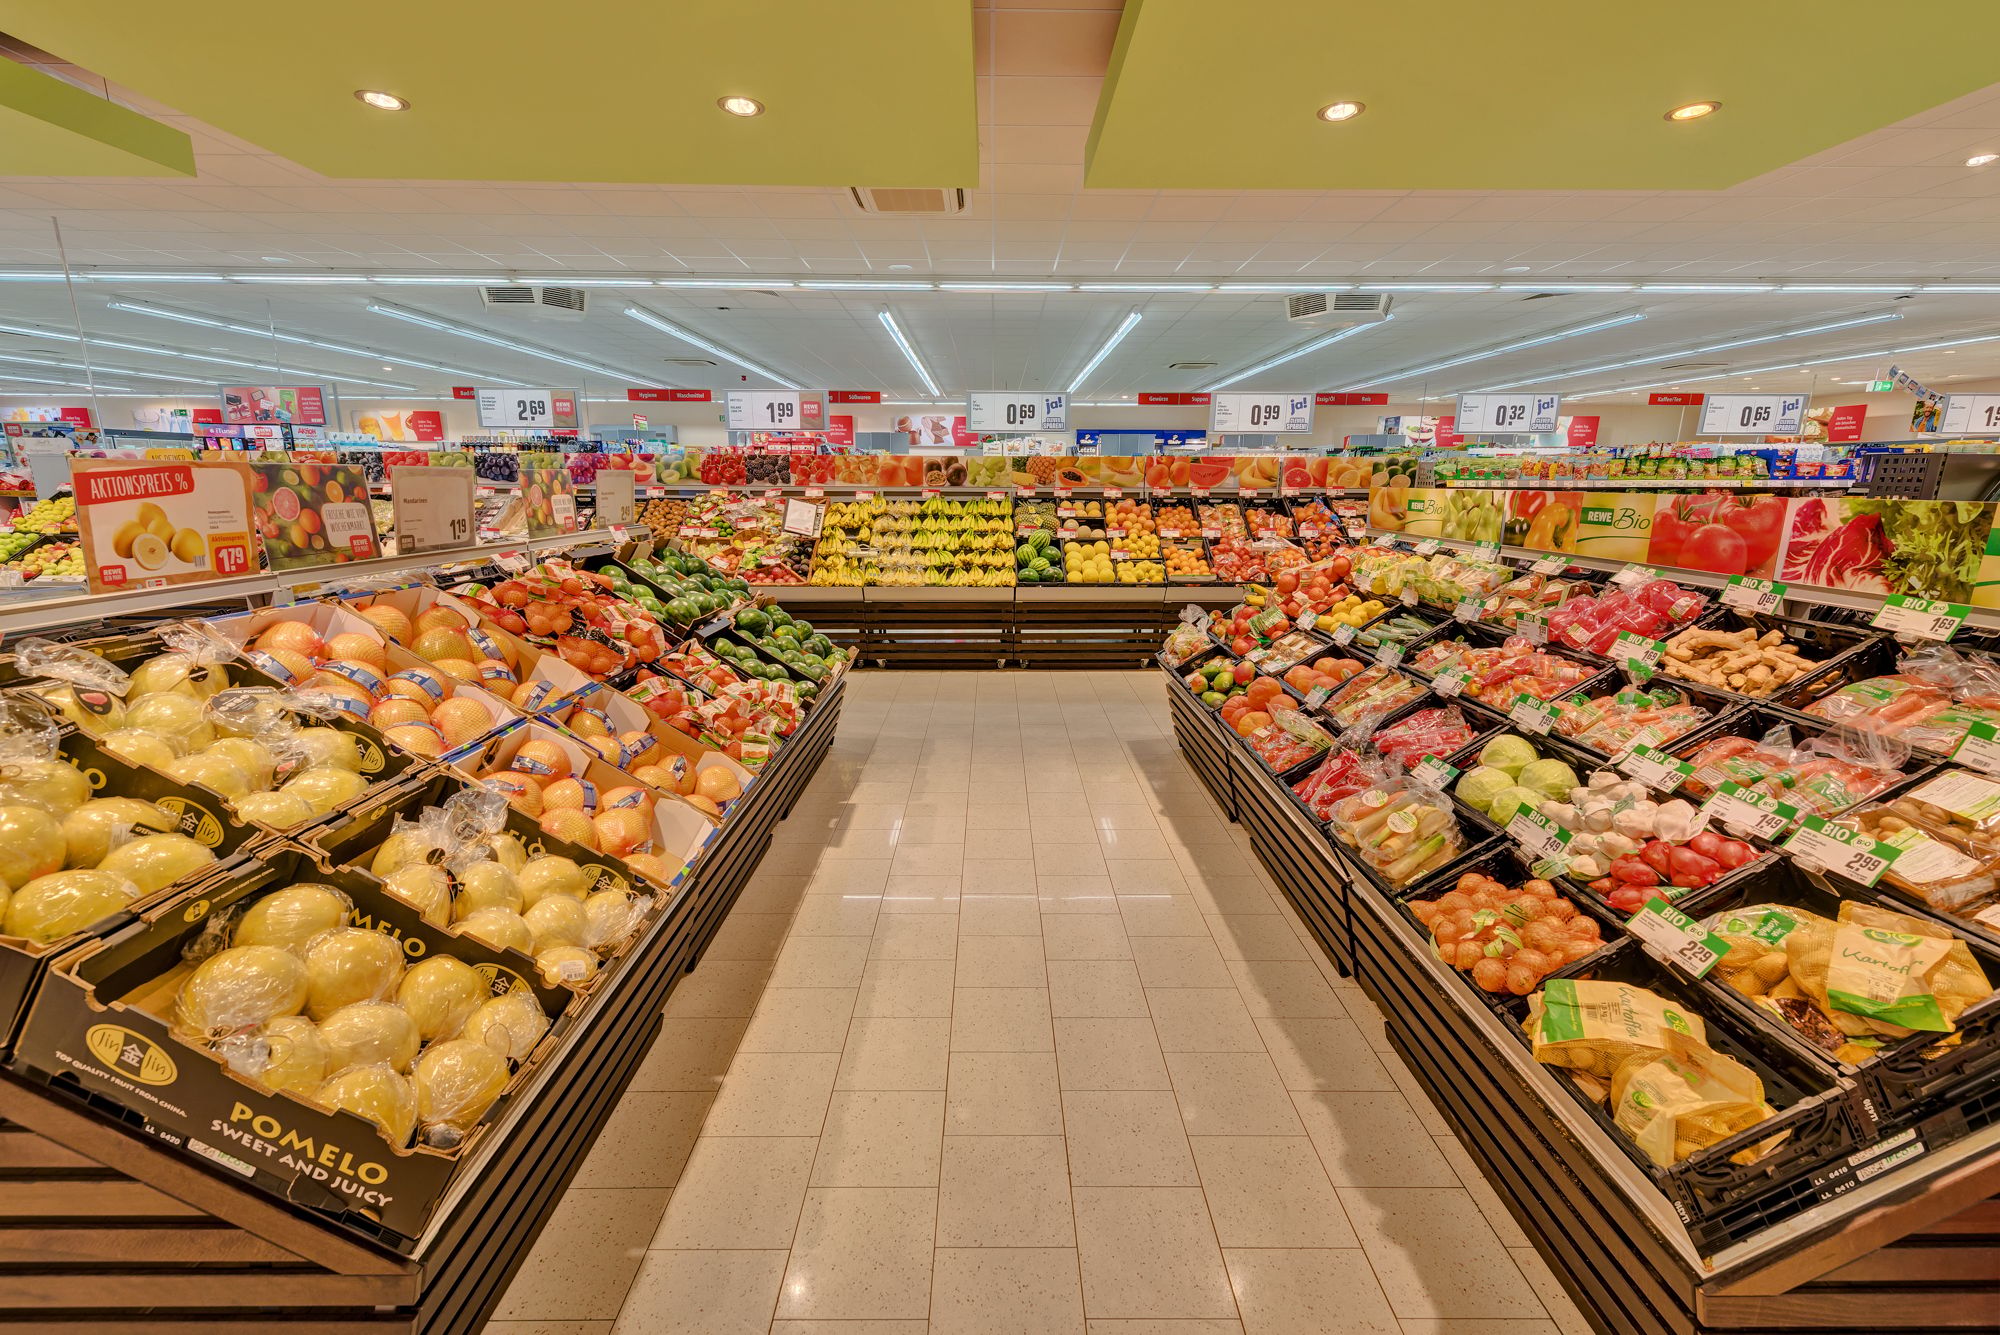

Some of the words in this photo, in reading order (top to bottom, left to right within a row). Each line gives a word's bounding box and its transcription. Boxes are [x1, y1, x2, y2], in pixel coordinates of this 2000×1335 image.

[517, 399, 546, 421] 2.69
[766, 402, 794, 423] 1.99
[1006, 403, 1036, 425] 0.69
[1045, 396, 1063, 415] ja!
[1250, 404, 1280, 426] 0.99
[1290, 397, 1308, 416] ja!
[1537, 397, 1555, 416] ja!
[1781, 398, 1800, 417] ja!
[1495, 405, 1526, 426] 0.32
[1740, 406, 1772, 427] 0.65
[215, 427, 237, 435] iTunes
[90, 472, 173, 500] AKTIONSPREIS
[174, 472, 189, 491] %
[1411, 502, 1425, 510] REWE
[1424, 499, 1443, 515] Bio
[1587, 511, 1613, 523] REWE
[1613, 508, 1651, 530] Bio
[450, 519, 467, 540] 1.19
[218, 547, 244, 572] 1.79
[103, 568, 122, 576] REWE
[1740, 577, 1759, 589] BIO
[1757, 592, 1778, 607] 0.69
[1902, 597, 1927, 611] BIO
[1929, 617, 1956, 633] 1.69
[1627, 633, 1643, 645] BIO
[1641, 650, 1658, 662] 1.69
[1526, 696, 1541, 709] BIO
[1645, 749, 1665, 762] BIO
[1660, 770, 1684, 784] 1.49
[1733, 787, 1759, 803] BIO
[181, 812, 199, 833] 金
[1528, 810, 1546, 826] BIO
[1755, 813, 1783, 829] 1.49
[1821, 822, 1851, 841] BIO
[1542, 836, 1561, 852] 1.49
[1845, 852, 1882, 872] 2.99
[1660, 906, 1687, 927] BIO
[1678, 940, 1713, 963] 2.29
[96, 1031, 120, 1053] Jin
[120, 1043, 144, 1068] 金
[143, 1056, 166, 1075] Jin
[55, 1050, 73, 1063] TOP
[72, 1060, 111, 1080] QUALITY
[110, 1076, 135, 1092] FRUIT
[134, 1087, 159, 1104] FROM
[145, 1124, 156, 1135] LL
[229, 1101, 389, 1185] POMELO
[210, 1119, 279, 1158] SWEET
[278, 1153, 329, 1181] AND
[330, 1175, 393, 1207] JUICY
[1814, 1177, 1826, 1186] LL
[1821, 1191, 1833, 1200] LL
